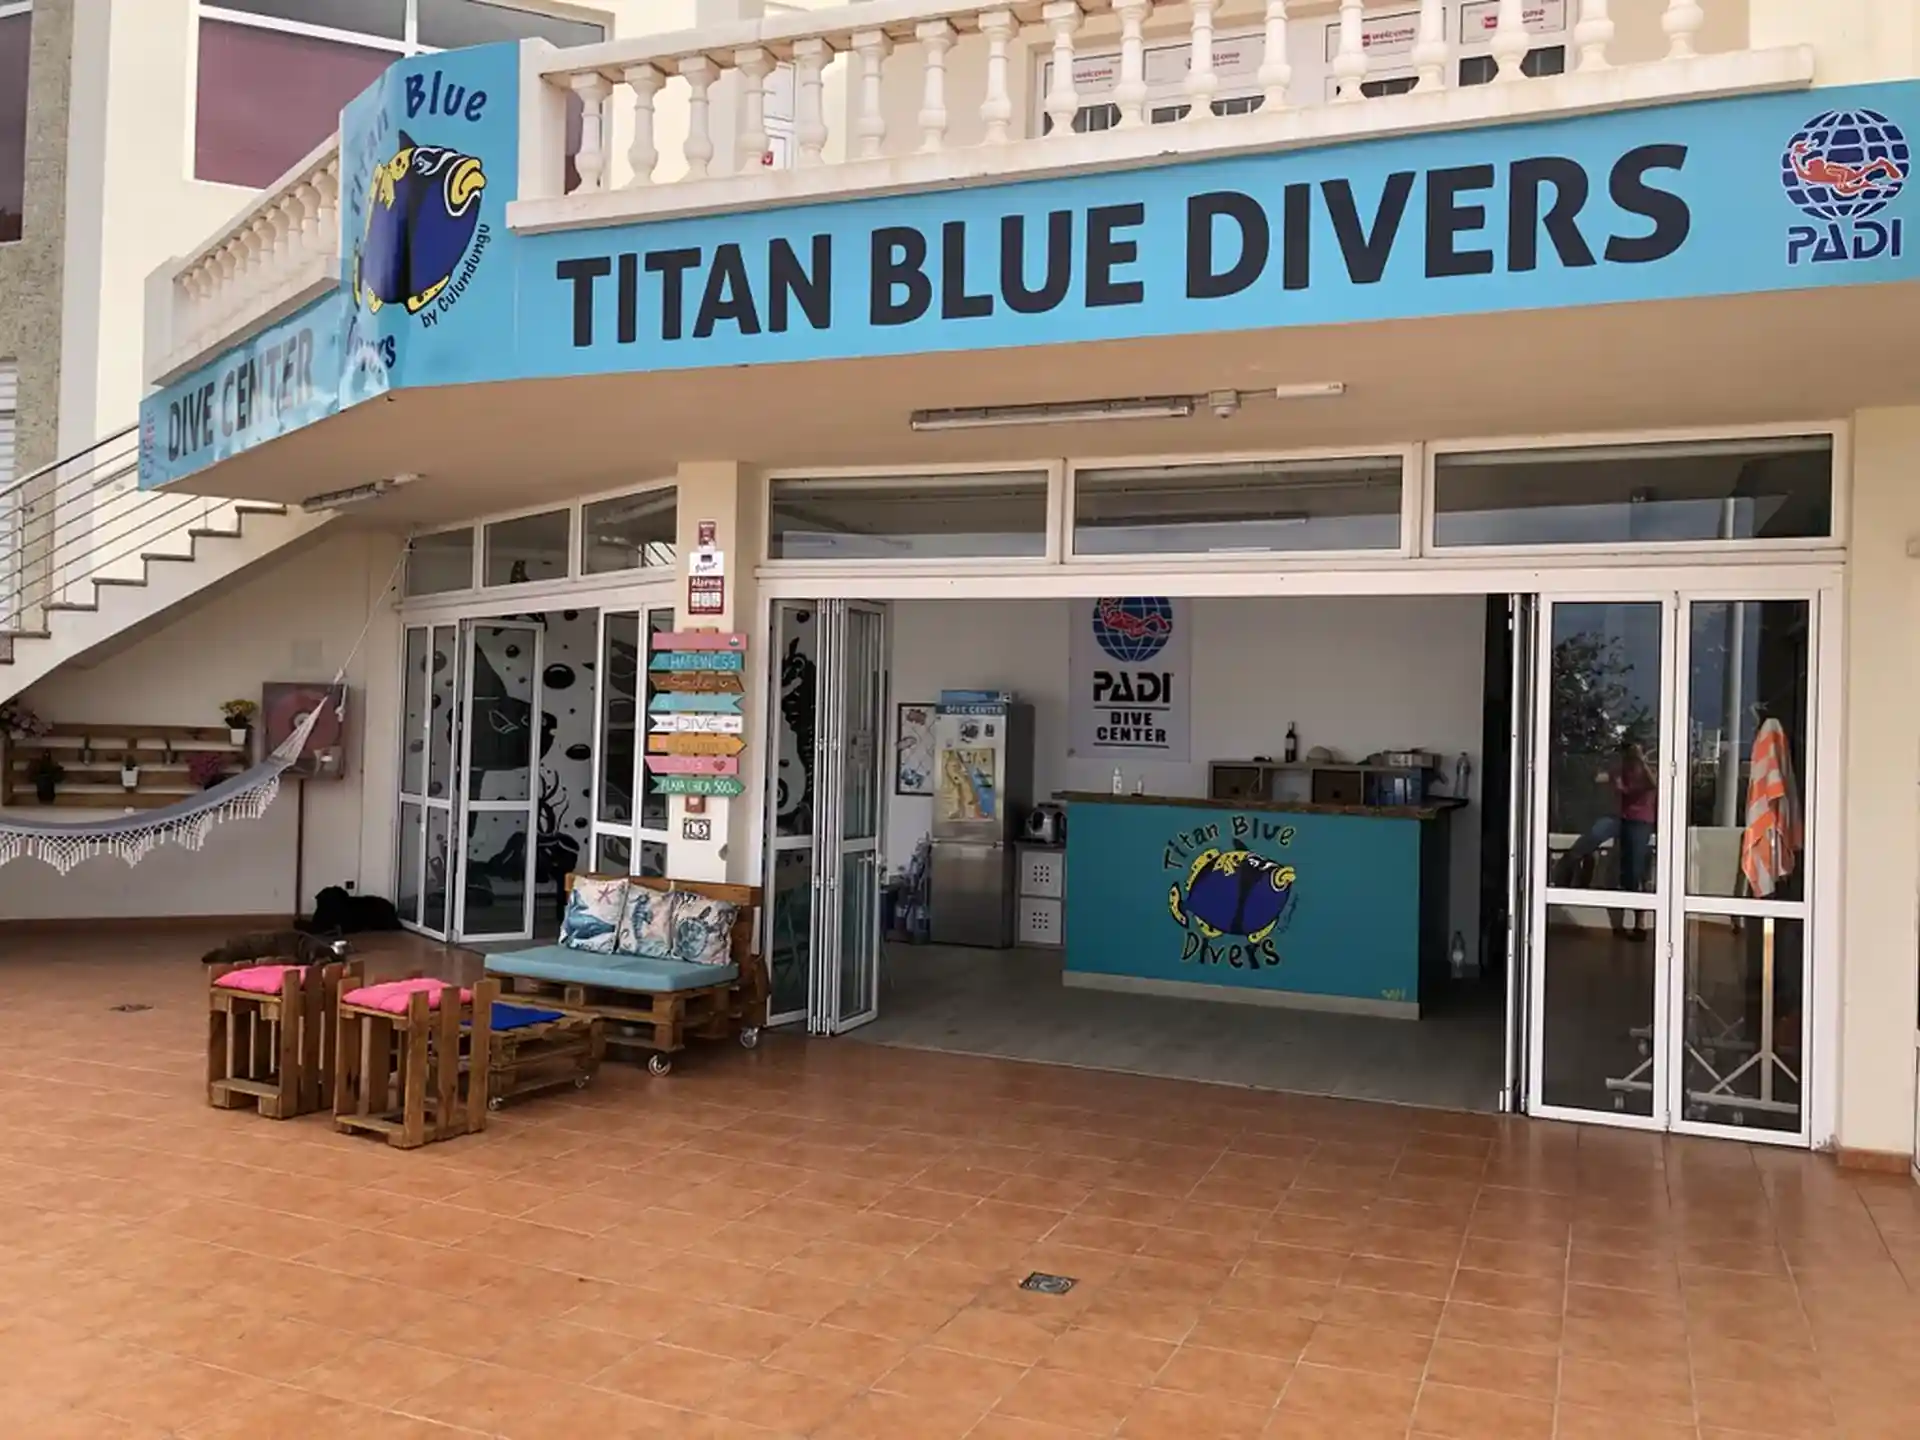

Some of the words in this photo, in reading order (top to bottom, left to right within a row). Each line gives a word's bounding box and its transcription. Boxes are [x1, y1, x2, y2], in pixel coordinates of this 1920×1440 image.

[405, 70, 488, 122] Blue
[557, 232, 831, 347] TITAN
[870, 202, 1145, 326] BLUE
[1187, 144, 1691, 299] DIVERS
[1788, 218, 1903, 266] PADI
[420, 308, 438, 328] by
[438, 223, 491, 312] Culundungu
[168, 381, 215, 462] DIVE
[221, 328, 313, 437] CENTER
[1093, 671, 1171, 703] PADI
[677, 716, 718, 731] DIVE
[1096, 727, 1166, 742] CENTER
[1110, 711, 1152, 726] DIVE
[1164, 823, 1219, 869] Titan
[1232, 815, 1296, 846] Blue
[1180, 931, 1281, 970] Divers
